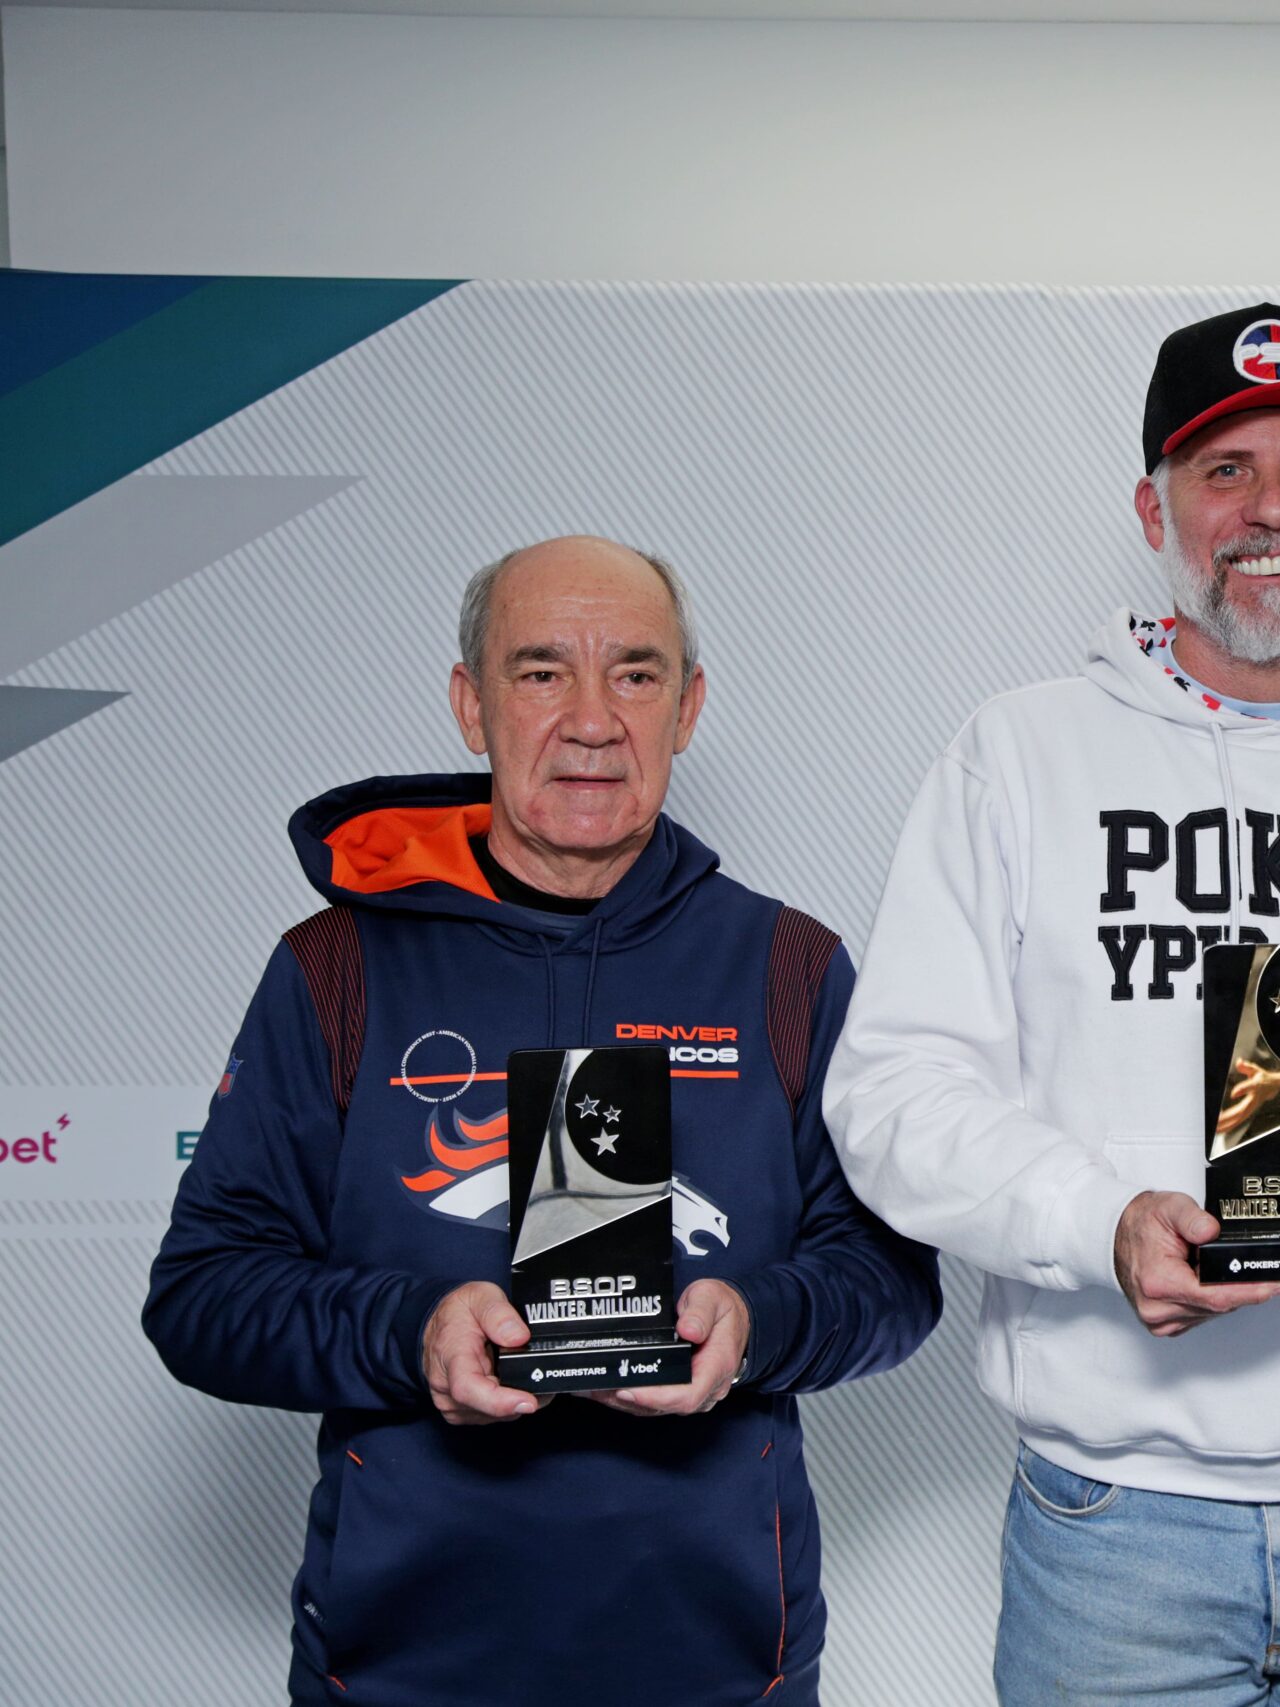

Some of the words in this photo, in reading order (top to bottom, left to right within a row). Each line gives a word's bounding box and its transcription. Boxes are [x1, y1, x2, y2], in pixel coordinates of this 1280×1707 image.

[616, 1023, 738, 1042] DENVER
[1219, 1198, 1278, 1220] WINTER
[550, 1275, 637, 1299] BSOP
[525, 1300, 588, 1324] WINTER
[591, 1295, 662, 1319] MILLIONS
[545, 1366, 608, 1379] POKERSTARS
[630, 1363, 660, 1375] vbet
